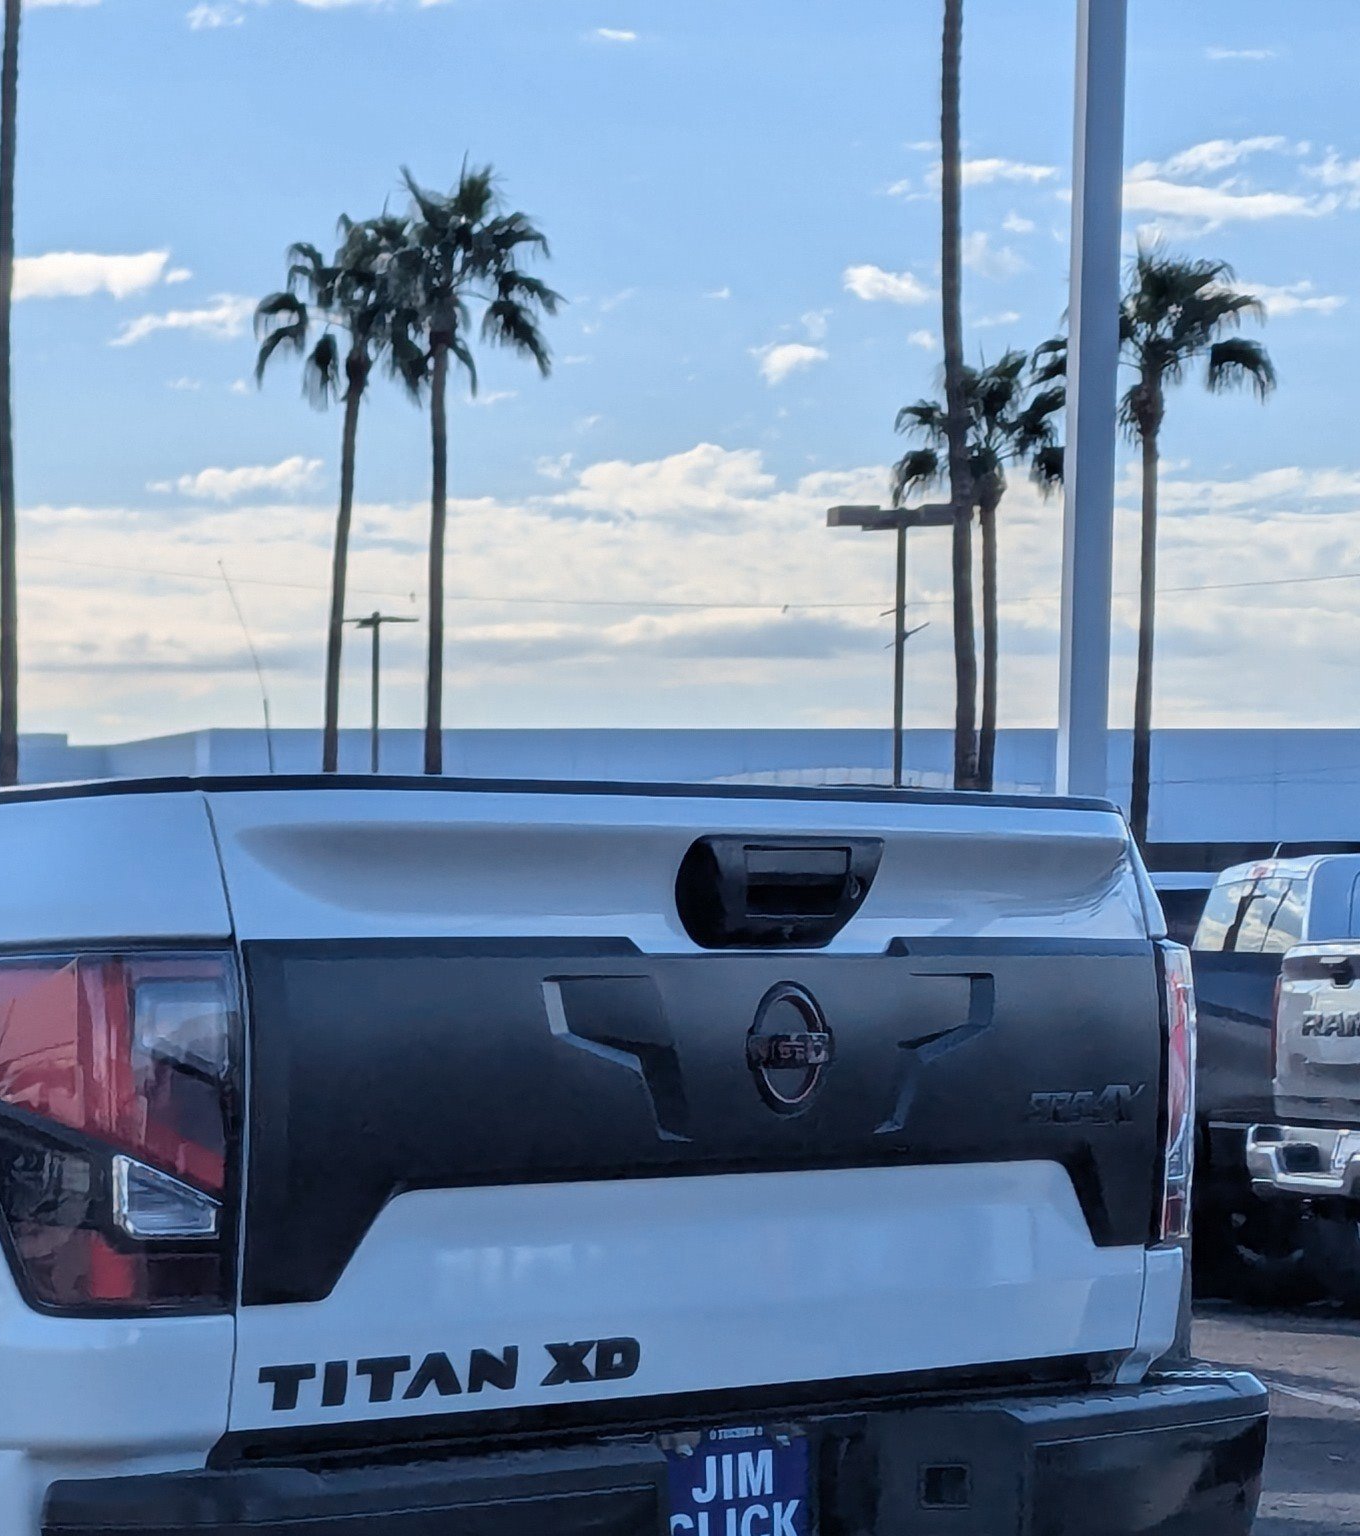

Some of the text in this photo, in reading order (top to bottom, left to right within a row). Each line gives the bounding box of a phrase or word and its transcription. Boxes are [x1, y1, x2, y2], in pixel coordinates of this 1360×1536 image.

[258, 1336, 641, 1411] TITAN XD
[691, 1449, 774, 1504] JIM
